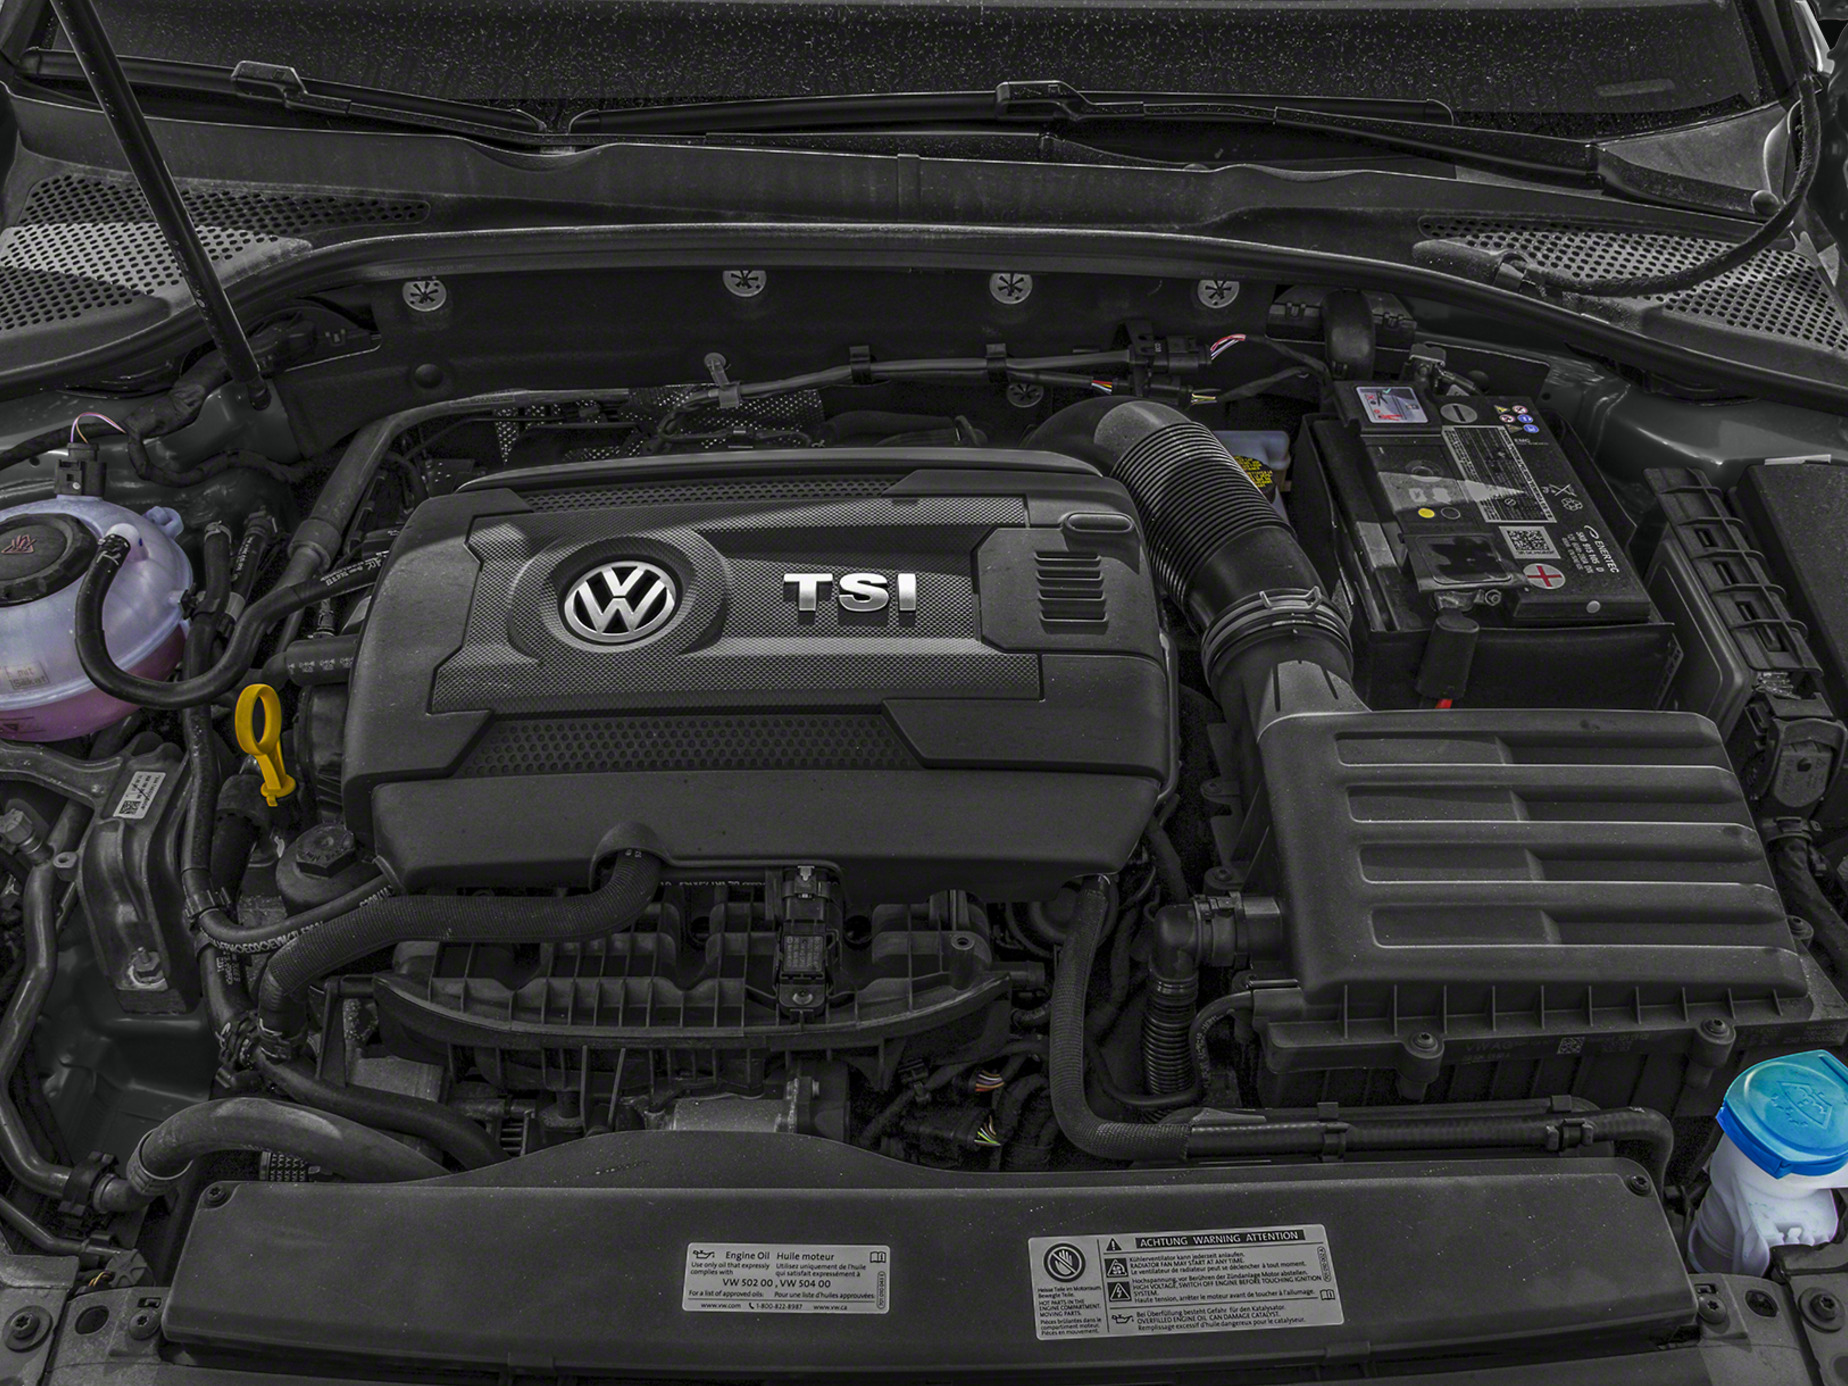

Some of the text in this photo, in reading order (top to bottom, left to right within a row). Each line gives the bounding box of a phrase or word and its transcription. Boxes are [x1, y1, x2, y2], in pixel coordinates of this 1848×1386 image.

[1594, 540, 1620, 573] ENERTEC
[783, 573, 917, 612] TSI
[1140, 1231, 1298, 1247] ACHTUNG WARNING ATTENTION
[726, 1252, 755, 1261] Engine
